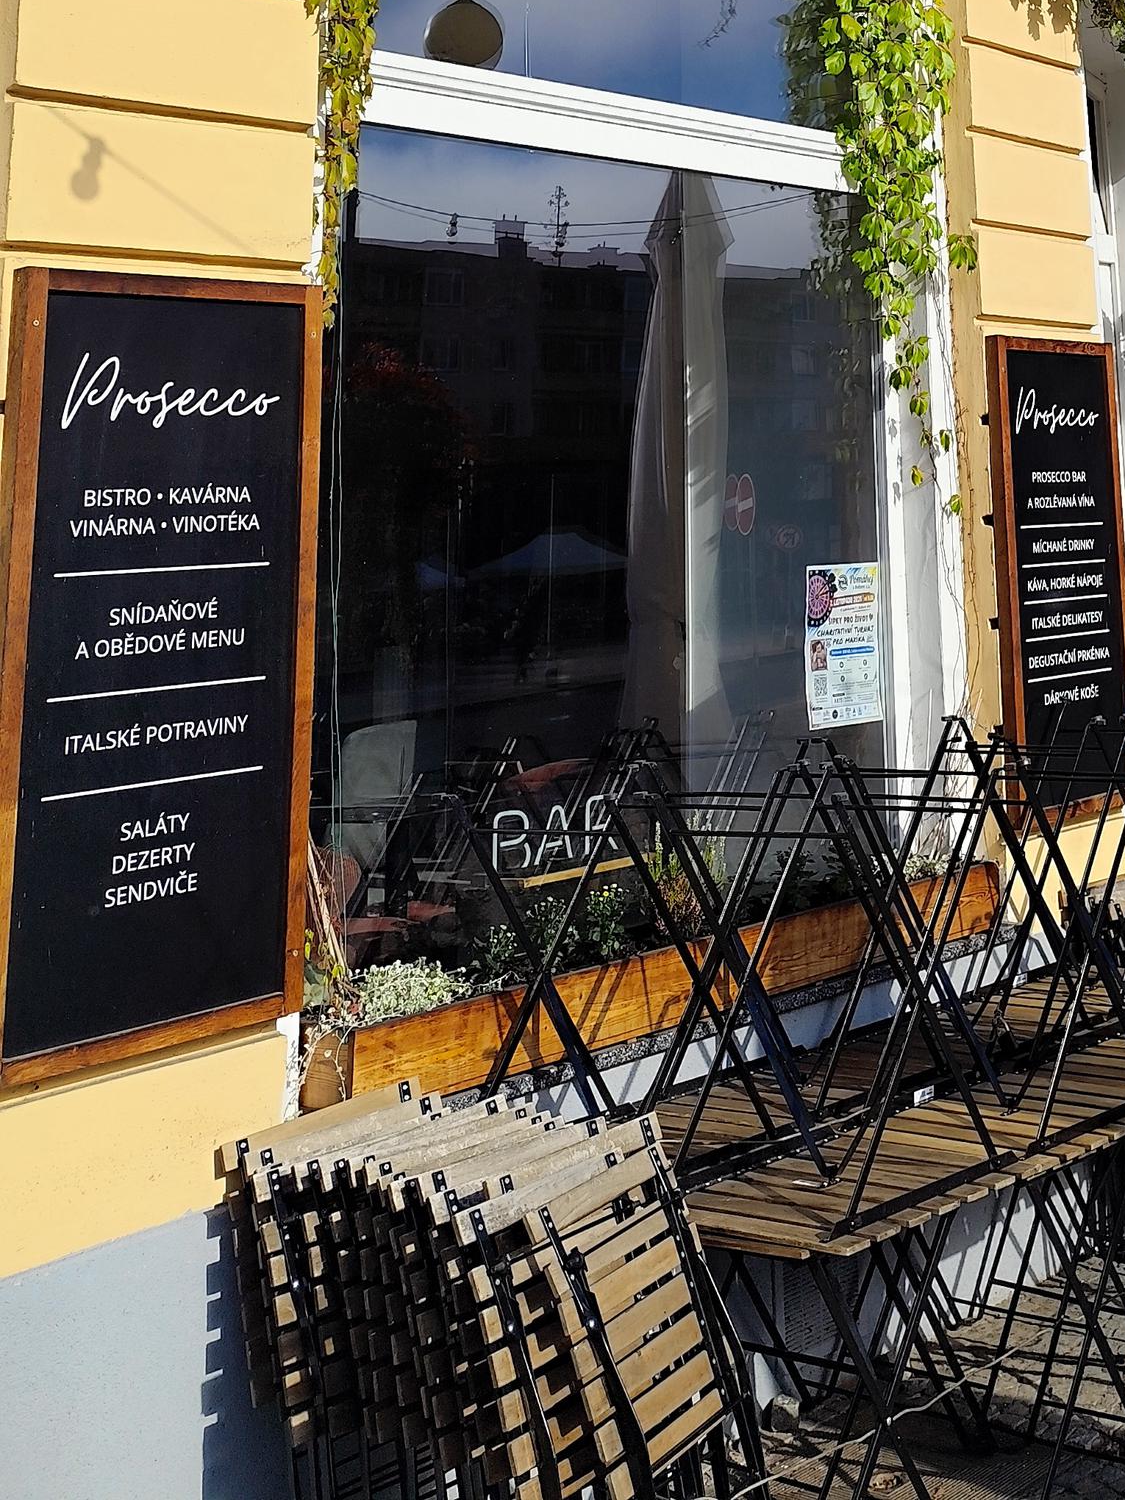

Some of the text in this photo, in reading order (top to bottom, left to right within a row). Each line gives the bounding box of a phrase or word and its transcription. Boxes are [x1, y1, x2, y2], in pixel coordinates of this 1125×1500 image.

[61, 352, 280, 429] Prosecco
[1016, 386, 1099, 434] Prosecco
[1031, 471, 1087, 483] PROSECCO BAR
[84, 483, 251, 507] BISTRO KAVÁRNA
[1027, 493, 1095, 509] A ROZLÉVANÁ VÍNA
[69, 512, 260, 537] VINÁRNA VINOTÉKA
[1033, 539, 1095, 553] MÍCHANÉ DRINKY
[1027, 572, 1103, 592] KÁVA, HORKÉ NÁPOJE
[109, 597, 218, 626] SNÍDAŇOVÉ
[843, 615, 853, 624] PRO
[1031, 611, 1103, 630] ITALSKÉ DELIKATESY
[75, 628, 245, 660] A OBĚDOVÉ MENU
[1029, 646, 1110, 669] DEGUSTAČNÍ PRKÉNKA
[1080, 683, 1099, 700] KOŠE
[64, 715, 249, 755] ITALSKÉ POTRAVINY
[120, 812, 190, 841] SALÁTY
[492, 794, 619, 872] BAR
[112, 843, 195, 875] DEZERTY
[104, 870, 198, 908] SENDVIČE
